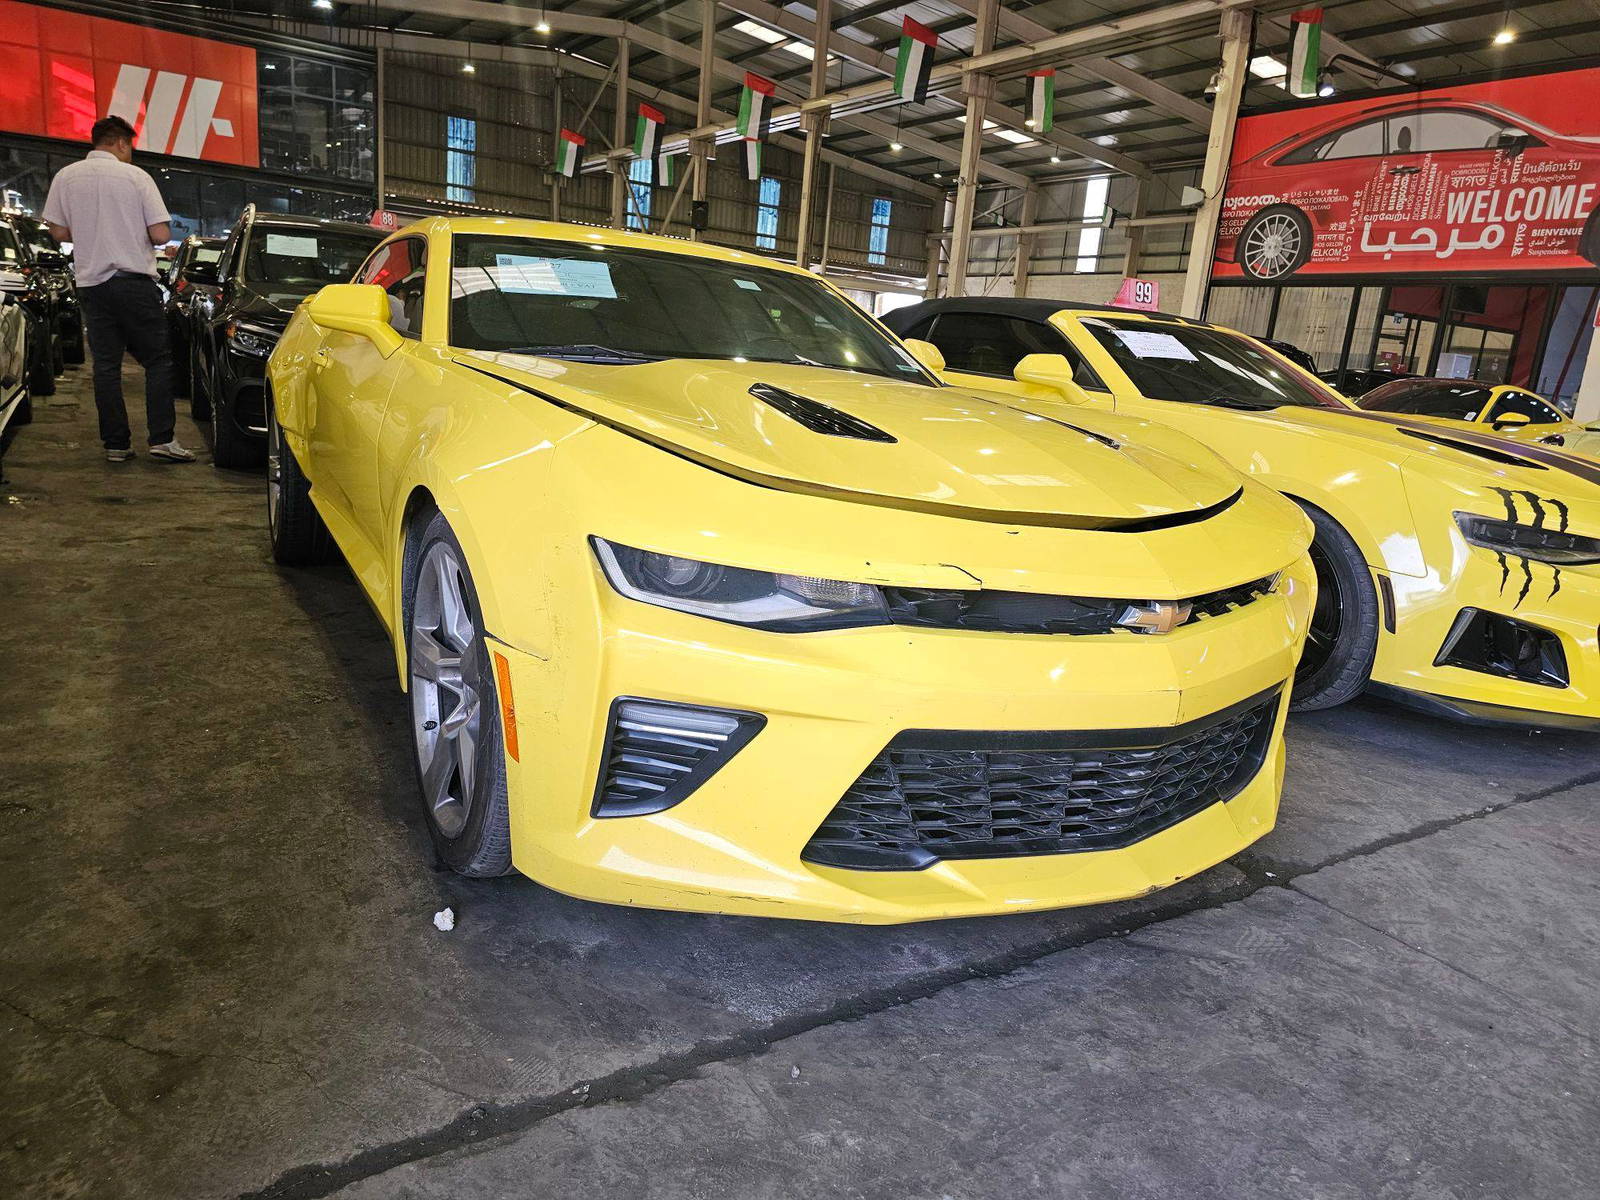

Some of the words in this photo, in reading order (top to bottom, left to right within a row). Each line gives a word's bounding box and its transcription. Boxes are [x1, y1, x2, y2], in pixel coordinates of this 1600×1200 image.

[1388, 164, 1404, 211] BIENVENE
[1418, 152, 1432, 193] ПОЖАЛОВА
[1488, 149, 1503, 189] WELKOM
[1420, 163, 1438, 220] WILLKOMMEN
[1433, 174, 1449, 219] Suspendisse
[1446, 183, 1596, 224] WELCOME
[1360, 221, 1505, 260] مرحبا
[1531, 227, 1584, 237] BIENVENUE
[1136, 281, 1152, 303] 99
